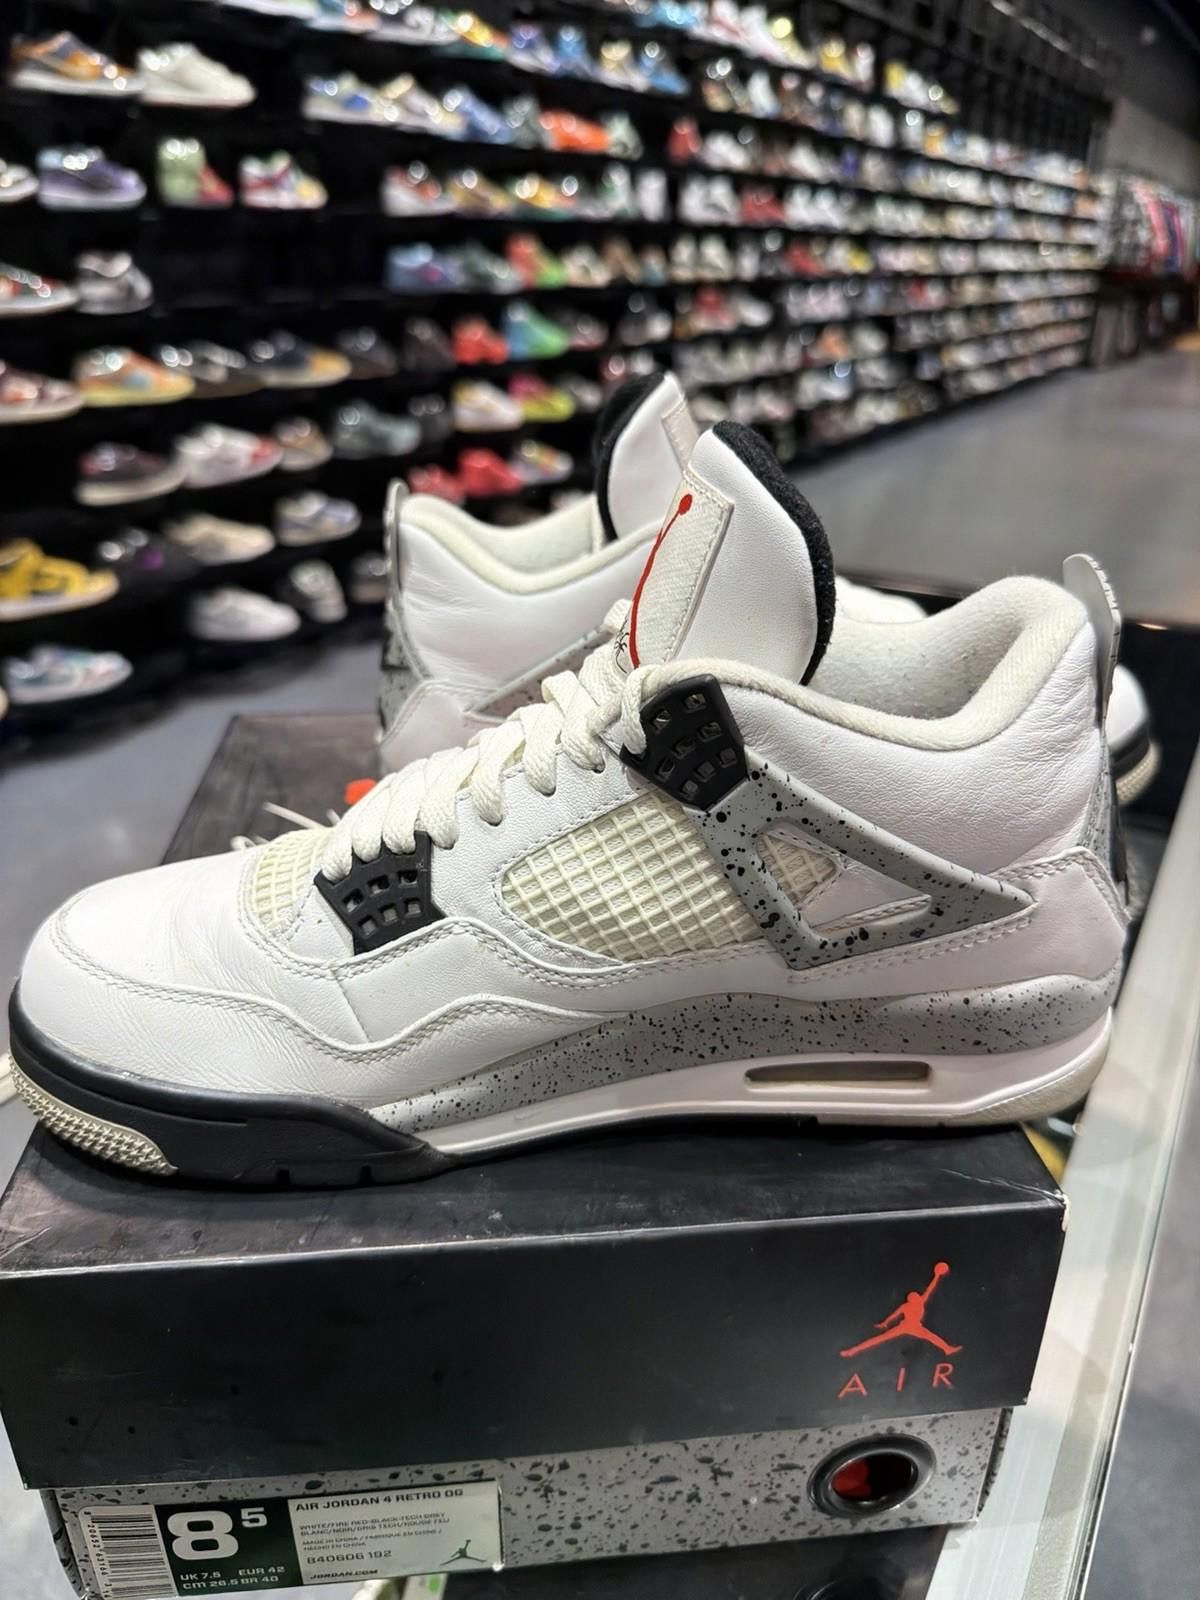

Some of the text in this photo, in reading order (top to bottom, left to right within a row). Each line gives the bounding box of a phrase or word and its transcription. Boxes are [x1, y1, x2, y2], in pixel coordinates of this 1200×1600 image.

[837, 1362, 954, 1399] AIR
[296, 1488, 464, 1511] AIR JORDAN 4 RETRO OG
[241, 1507, 268, 1528] 5
[167, 1510, 239, 1561] 8
[180, 1573, 198, 1581] UK
[200, 1571, 221, 1580] 7.5
[238, 1567, 265, 1576] EUR
[261, 1575, 279, 1583] 40
[309, 1569, 378, 1580] JORDAN.COM
